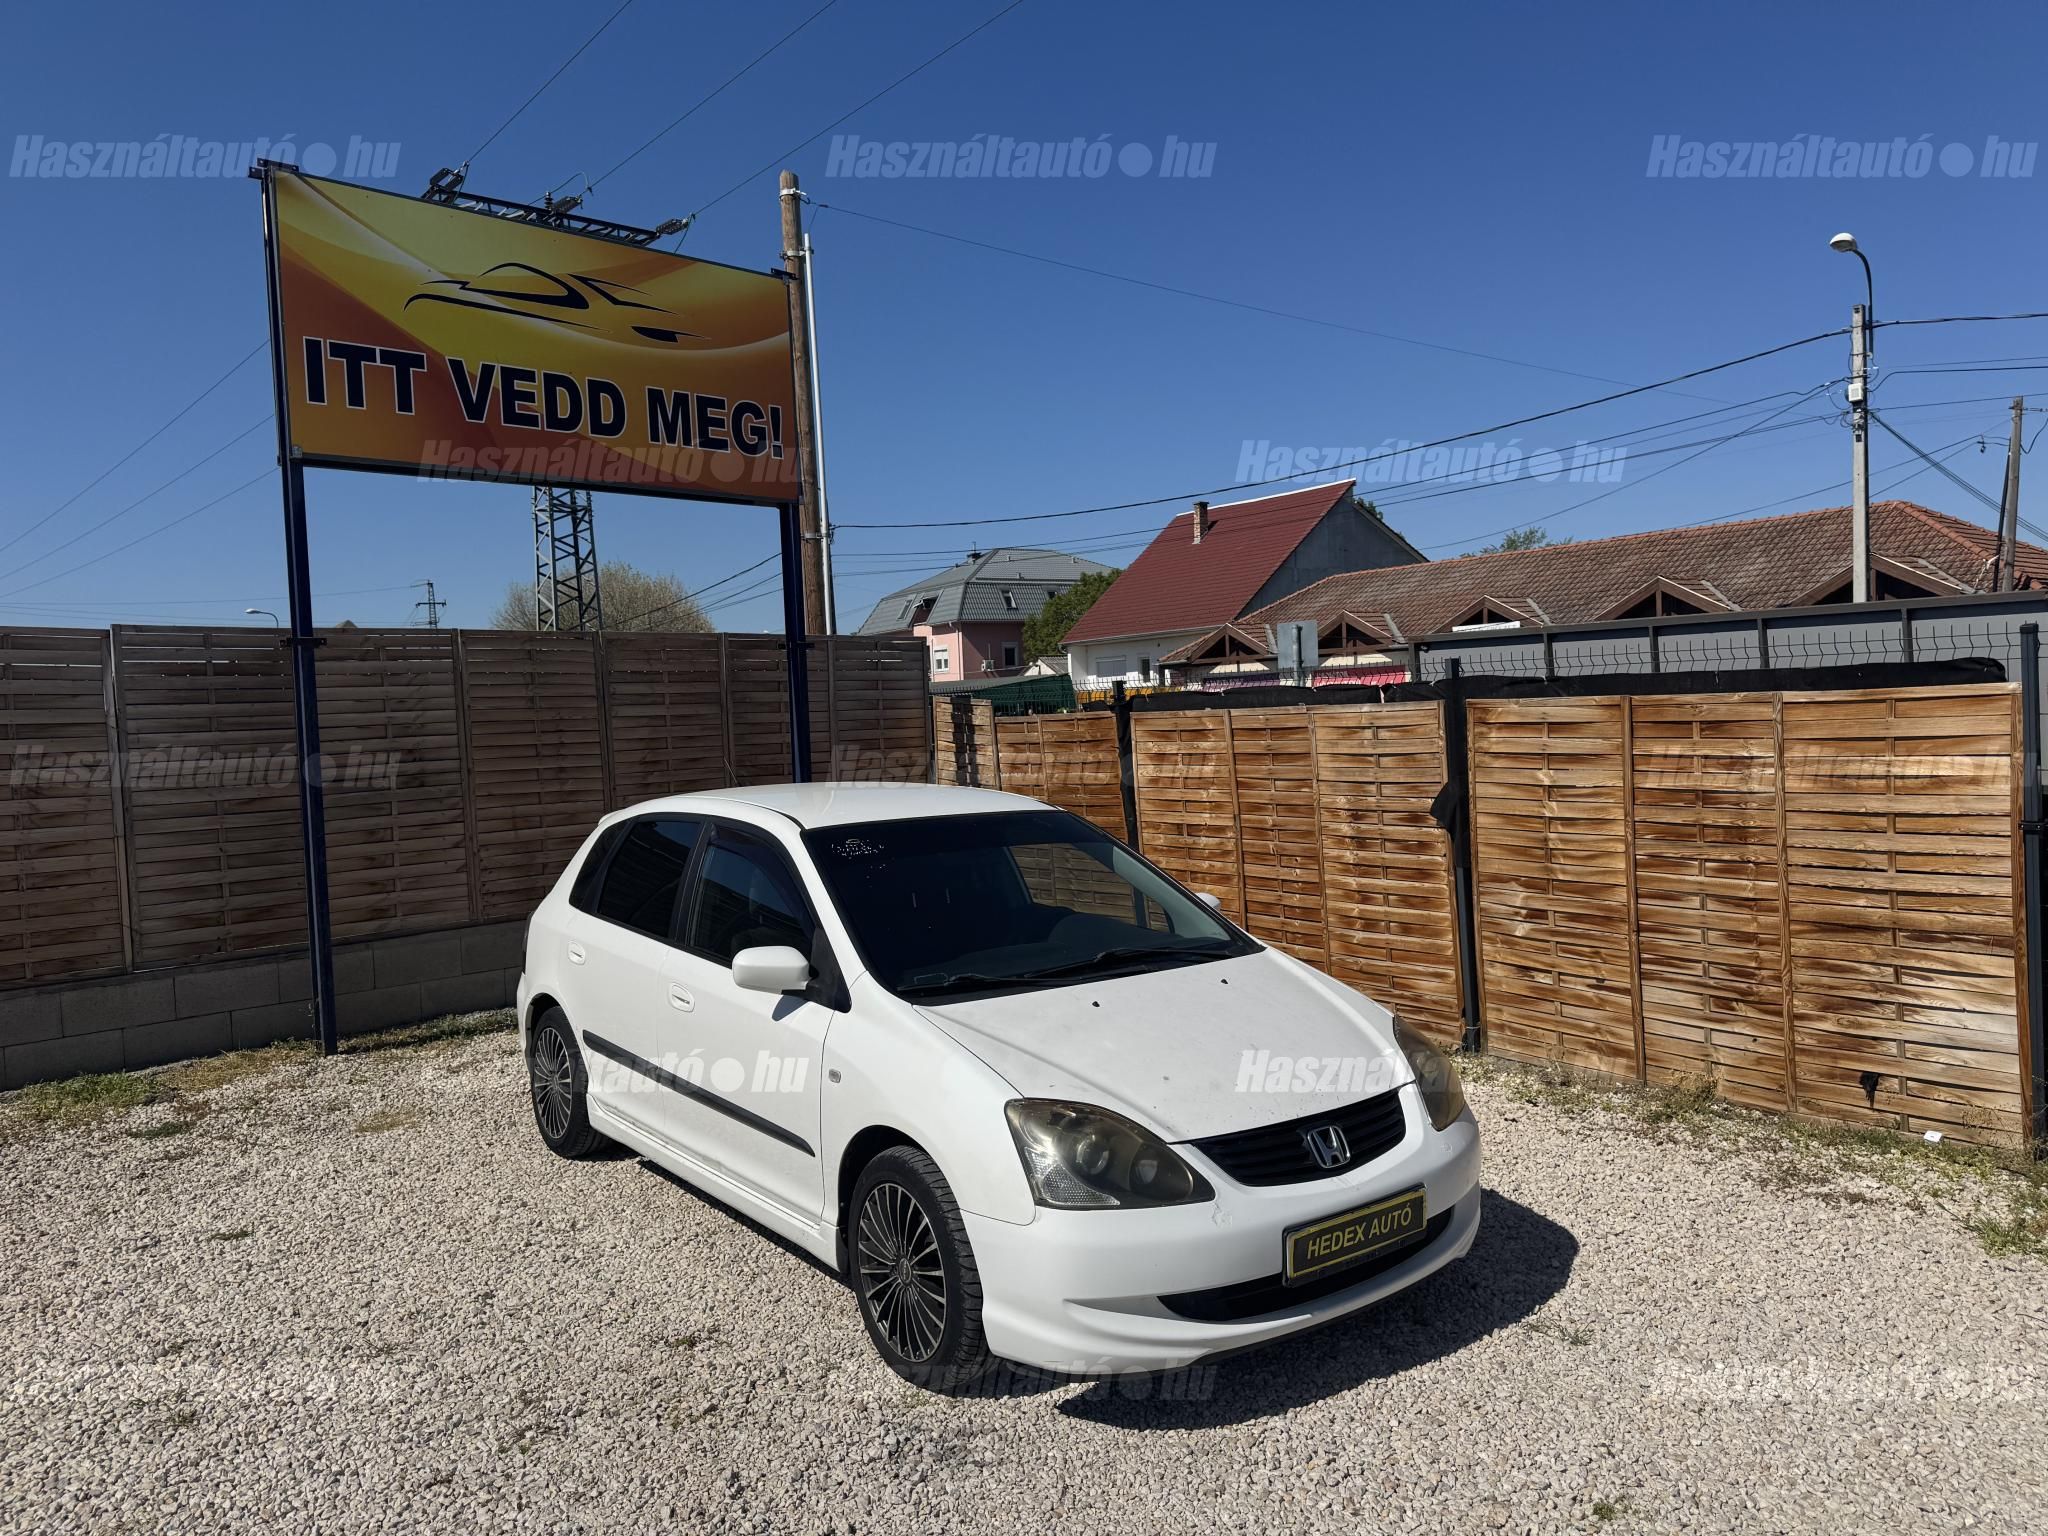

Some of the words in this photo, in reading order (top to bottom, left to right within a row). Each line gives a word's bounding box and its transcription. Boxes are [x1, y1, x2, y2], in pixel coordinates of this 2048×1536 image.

[302, 336, 427, 415] ITT
[445, 357, 627, 438] VEDD
[645, 386, 785, 460] MEG!
[1307, 1221, 1367, 1260] HEDEX
[1368, 1202, 1412, 1239] AUTÓ
